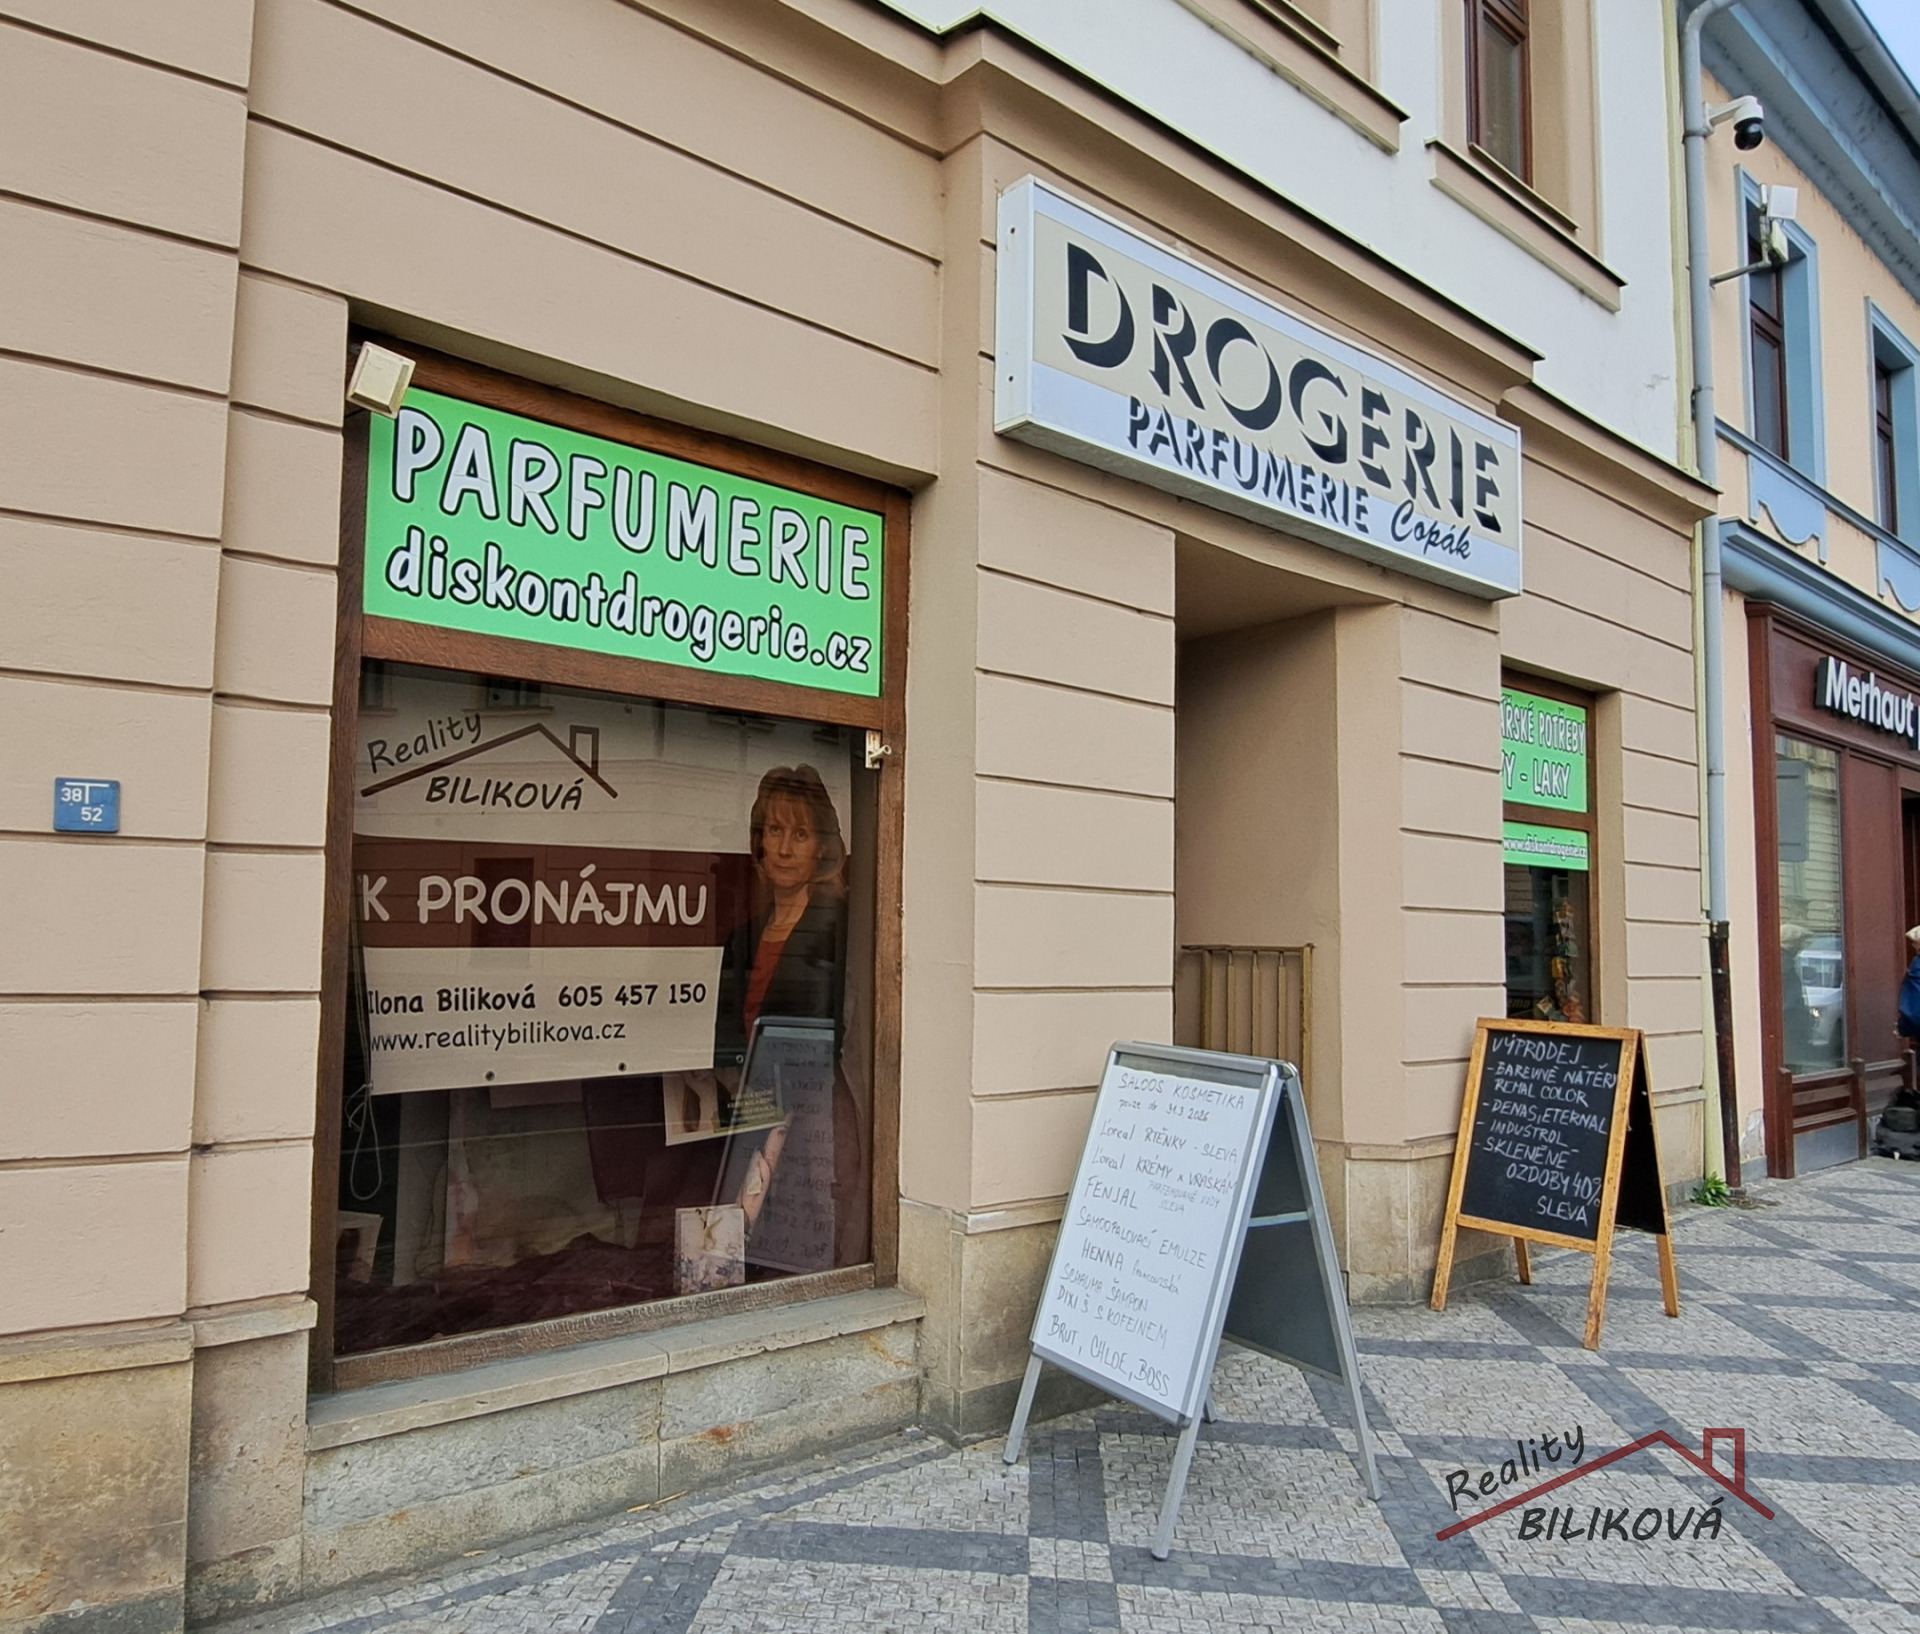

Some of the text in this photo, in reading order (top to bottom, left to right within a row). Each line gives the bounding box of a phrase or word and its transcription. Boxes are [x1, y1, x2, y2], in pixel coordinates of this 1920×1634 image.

[1061, 242, 1502, 533] DROGERIE
[1126, 395, 1472, 561] PARFUMERIE Copák
[391, 405, 870, 600] PARFUMERIE
[385, 525, 873, 673] diskontdrogerie.cz
[1825, 656, 1914, 738] Merhaut
[367, 713, 483, 774] Reality
[61, 787, 82, 802] 38
[425, 775, 583, 811] BILIKOVÁ
[1533, 757, 1571, 799] LAKY
[81, 806, 103, 822] 52
[362, 863, 707, 926] K PRONÁJMU
[368, 983, 707, 1015] Ilona Biliková 605 457 150
[370, 1020, 627, 1053] www.realitybilikova.cz
[1492, 1034, 1582, 1065] VÝPRODEJ
[1118, 1073, 1245, 1110] SALOOS KOSMETIKA
[1540, 1084, 1589, 1108] COLOR
[1144, 1127, 1187, 1151] RTĚNKY
[1200, 1142, 1238, 1163] SLEVA
[1491, 1119, 1569, 1148] INDUSTROL
[1136, 1154, 1173, 1179] KRÉMY
[1506, 1163, 1571, 1196] OZDOBY
[1083, 1175, 1138, 1210] FENJAL
[1537, 1195, 1589, 1227] SLEVA
[1081, 1238, 1124, 1272] HENNA
[1158, 1239, 1208, 1270] EMULZE
[1106, 1307, 1169, 1350] KOFEINEM
[1133, 1359, 1171, 1398] BOSS
